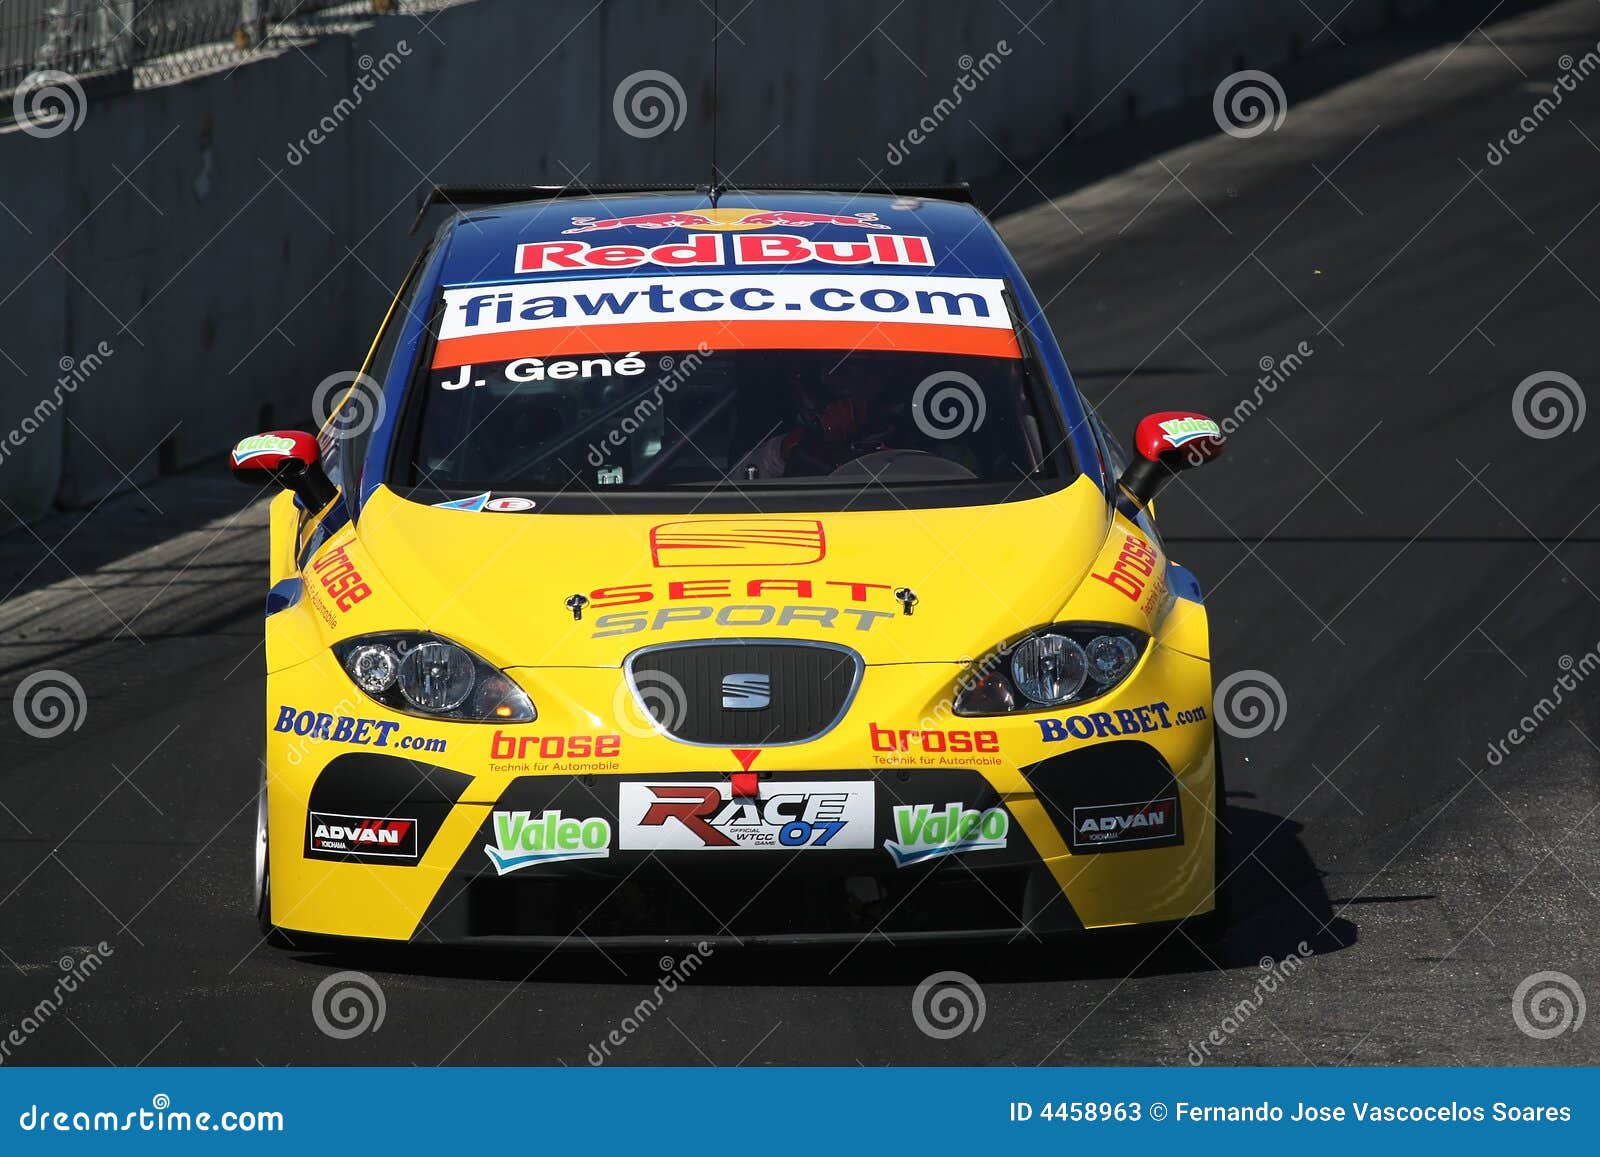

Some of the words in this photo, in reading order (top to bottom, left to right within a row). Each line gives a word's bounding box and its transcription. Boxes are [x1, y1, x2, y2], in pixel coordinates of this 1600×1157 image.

[514, 234, 725, 273] Red
[733, 234, 936, 266] Bull
[459, 286, 989, 326] fiawtcc.com
[441, 365, 486, 391] J.
[504, 351, 646, 383] Gené
[312, 537, 373, 613] brose
[1090, 534, 1158, 602] brose
[590, 579, 891, 608] SEAT
[591, 605, 895, 638] SPORT
[273, 705, 448, 753] BORBET.com
[869, 722, 1000, 753] brose
[1034, 701, 1208, 743] BORBET.com
[490, 730, 621, 760] brose
[919, 756, 935, 765] für
[939, 756, 1003, 766] Automobile
[488, 763, 530, 772] Technik
[533, 763, 549, 771] für
[552, 761, 620, 771] Automobile
[497, 814, 607, 851] Valeo
[638, 785, 849, 847] RACE
[778, 820, 849, 847] 07
[898, 807, 1006, 846] Valeo
[1080, 811, 1165, 832] ADVAN
[314, 824, 399, 844] ADVAN
[736, 833, 774, 841] WTCC
